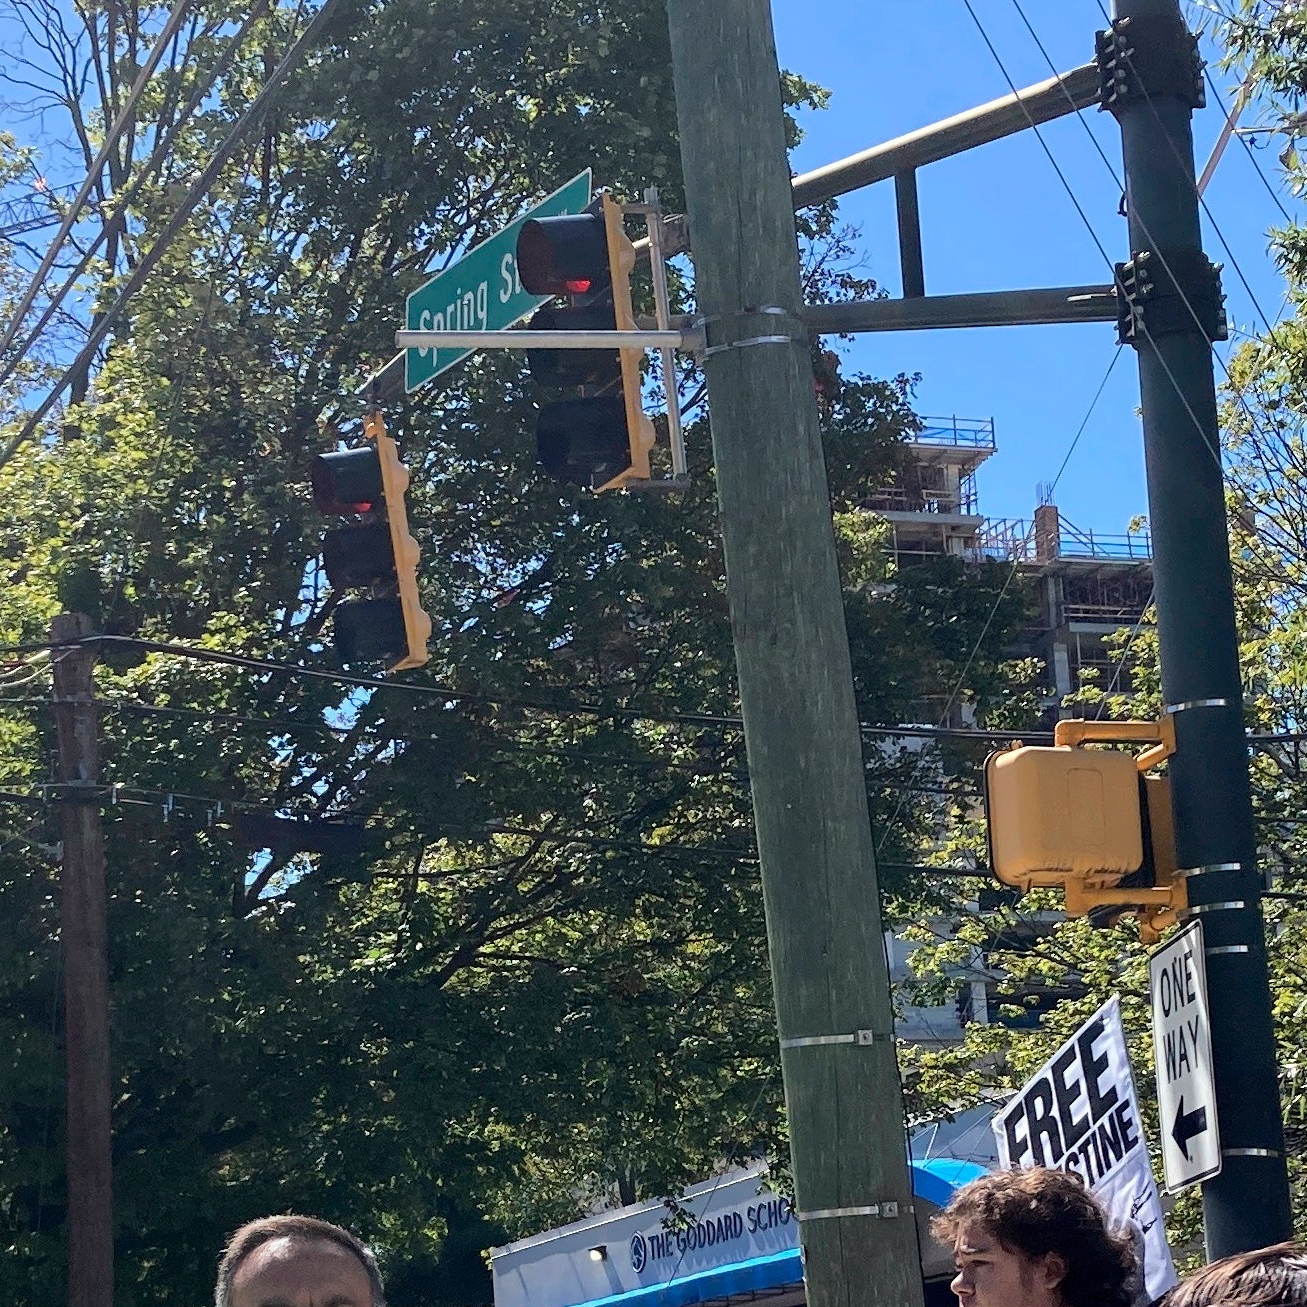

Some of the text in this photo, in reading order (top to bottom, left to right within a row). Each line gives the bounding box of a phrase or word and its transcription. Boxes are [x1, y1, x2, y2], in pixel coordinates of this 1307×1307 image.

[418, 281, 488, 368] Spring
[1160, 949, 1196, 1018] ONE
[1162, 1015, 1200, 1084] WAY
[1003, 1015, 1119, 1170] FREE
[1064, 1100, 1140, 1189] STINE
[648, 1232, 674, 1261] THE
[675, 1211, 744, 1252] GODDARD
